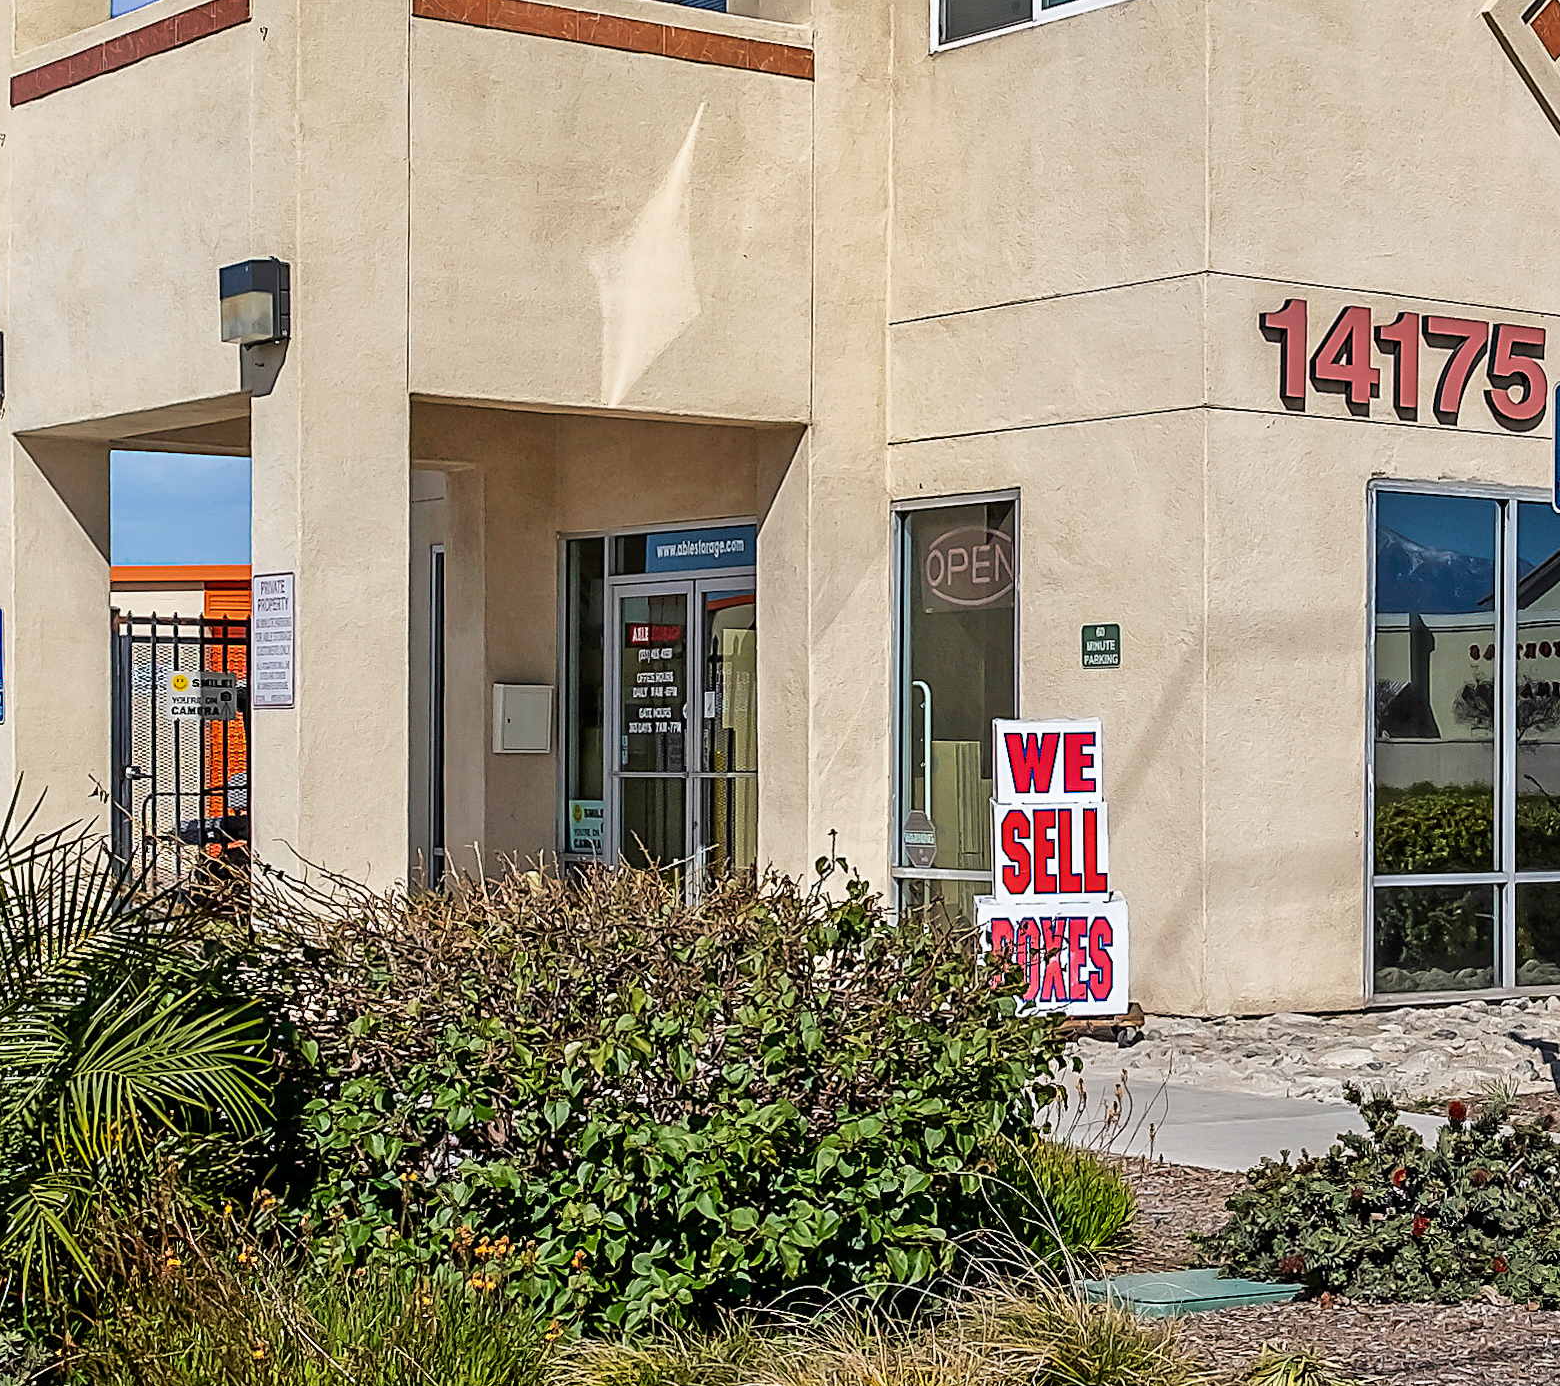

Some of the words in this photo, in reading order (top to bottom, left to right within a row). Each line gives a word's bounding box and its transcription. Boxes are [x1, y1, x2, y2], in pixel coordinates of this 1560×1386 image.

[1260, 299, 1548, 431] 14175
[656, 539, 744, 558] www.ablestorage.com
[926, 544, 1014, 587] OPEN
[260, 580, 285, 594] PRIVATE
[257, 597, 289, 612] PROPERTY
[1087, 640, 1115, 651] MINUTE
[1084, 654, 1118, 665] PARKING
[171, 706, 220, 715] CAMERA
[1003, 731, 1096, 794] WE
[1001, 808, 1108, 894] SELL
